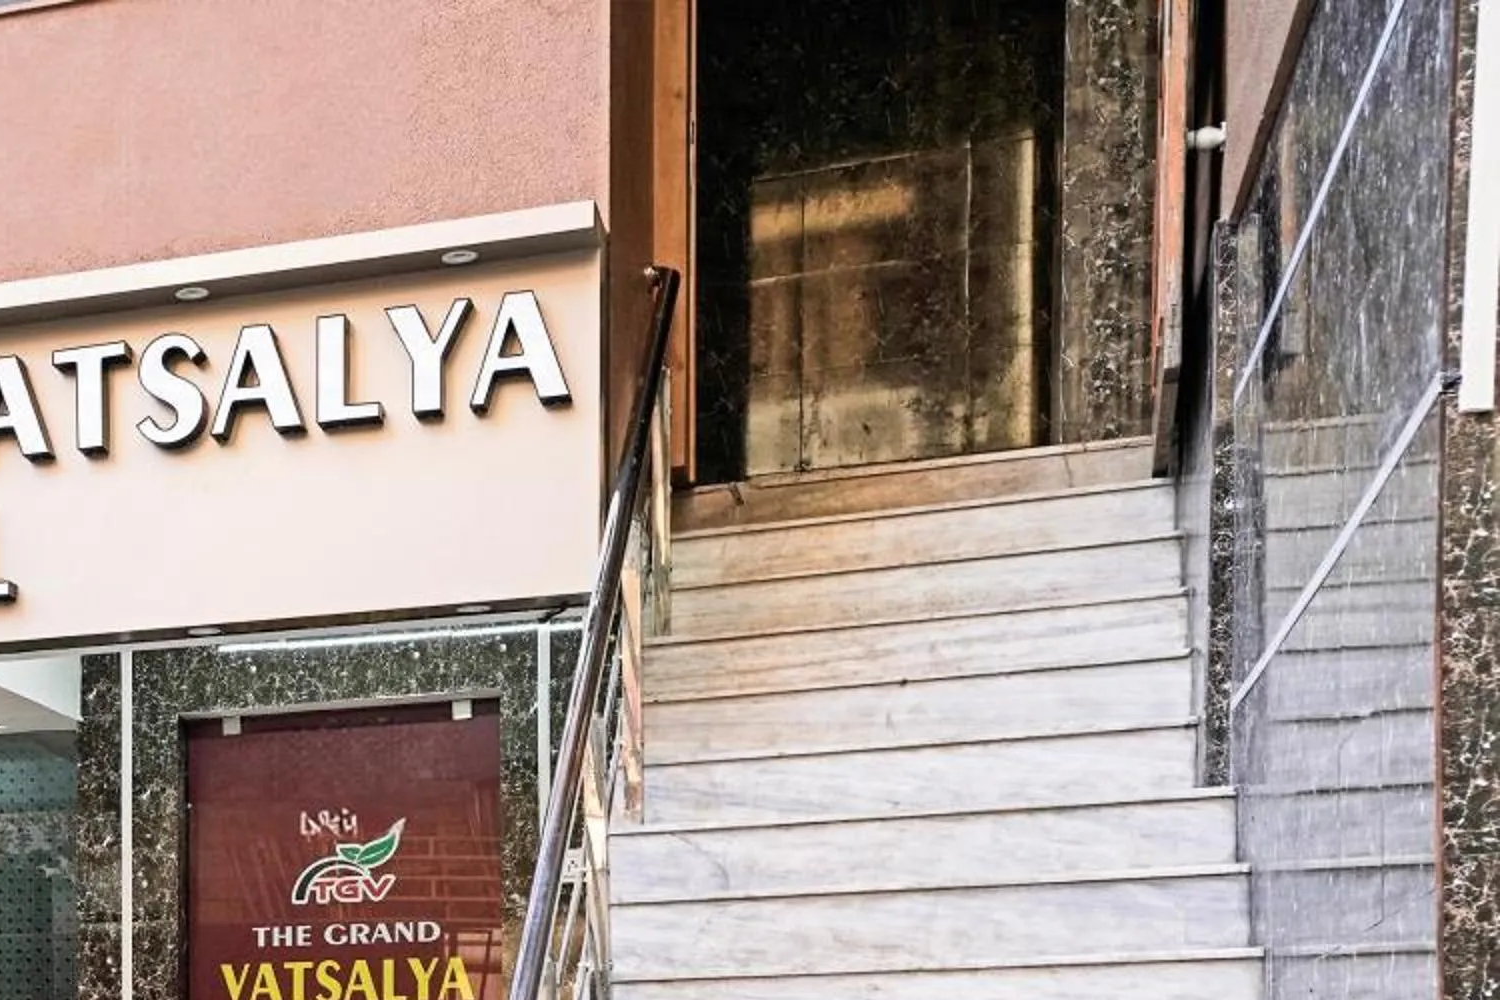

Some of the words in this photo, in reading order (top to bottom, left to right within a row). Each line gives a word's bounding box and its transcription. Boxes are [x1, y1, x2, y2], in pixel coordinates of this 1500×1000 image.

[310, 873, 396, 905] TGV
[252, 925, 312, 948] THE
[323, 921, 442, 945] GRAND
